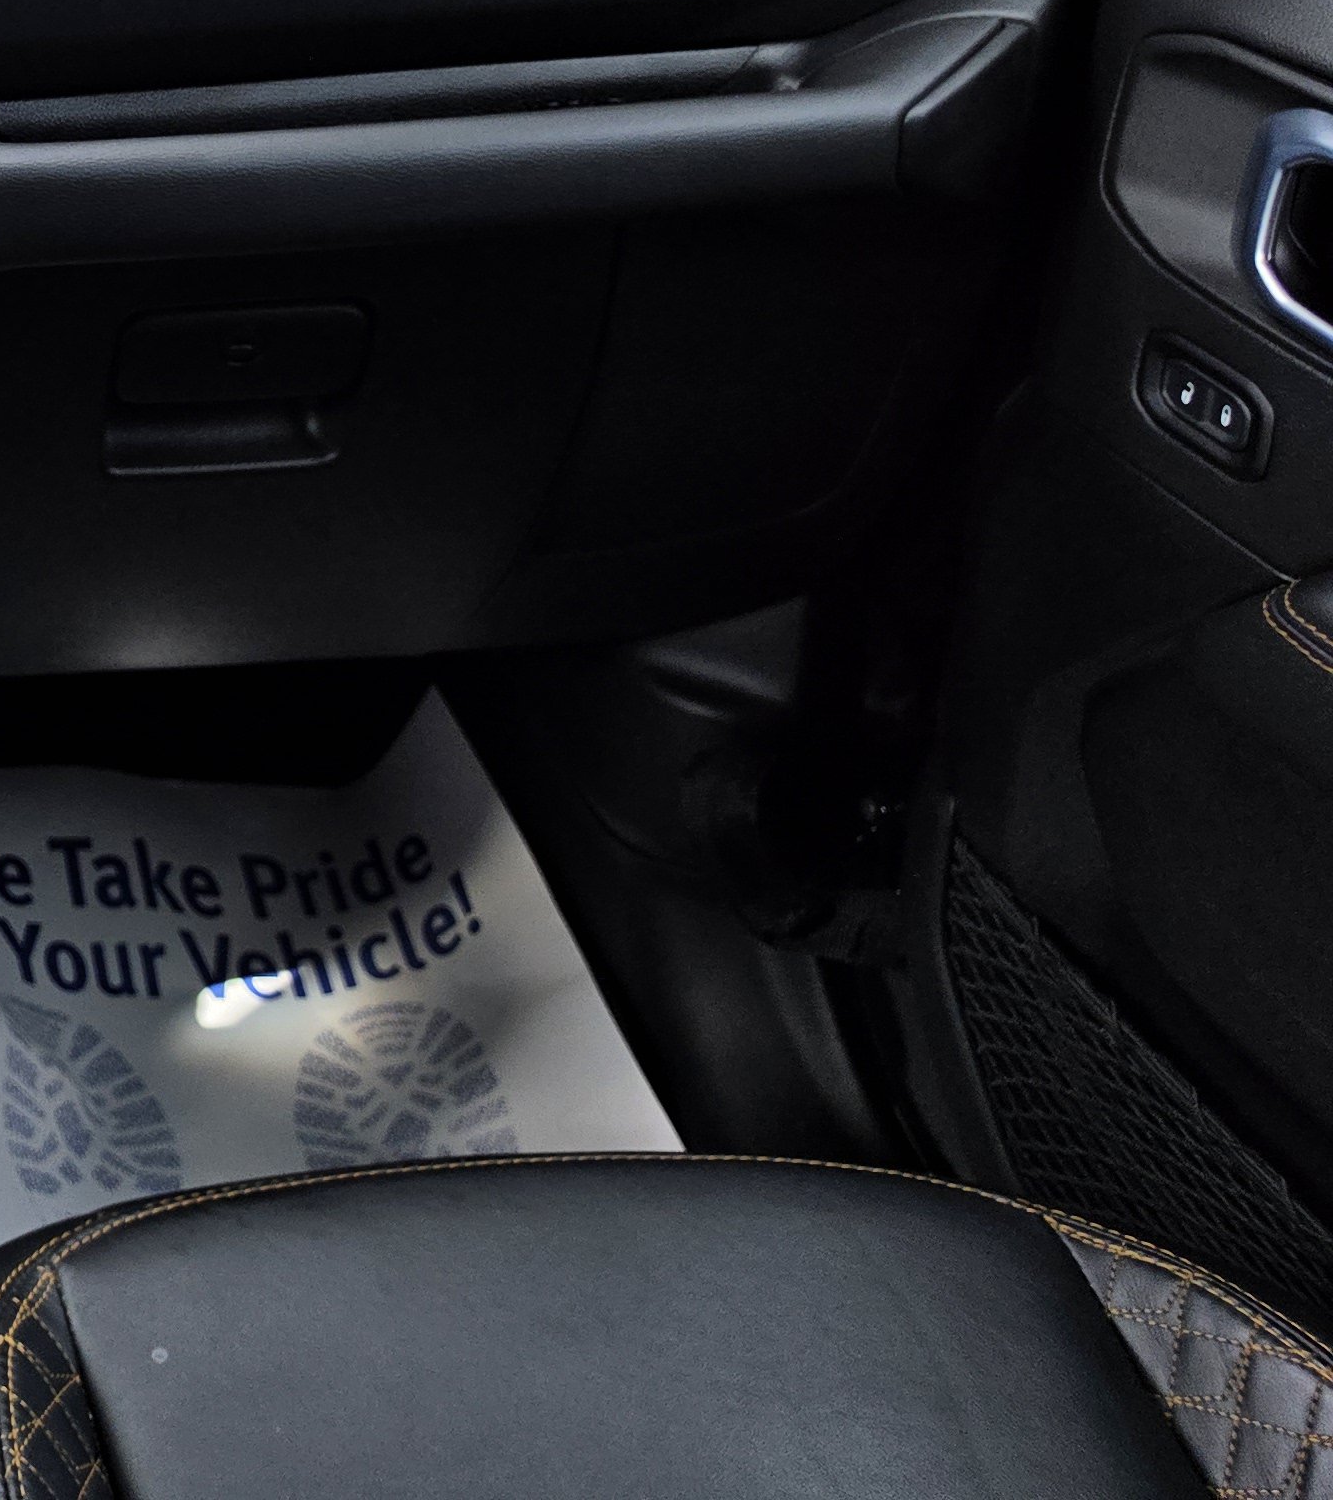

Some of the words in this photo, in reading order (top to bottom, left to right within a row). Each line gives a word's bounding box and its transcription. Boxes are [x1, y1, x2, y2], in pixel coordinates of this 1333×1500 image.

[47, 834, 224, 919] Take
[241, 828, 435, 923] Pride
[180, 871, 483, 1002] Vehicle!
